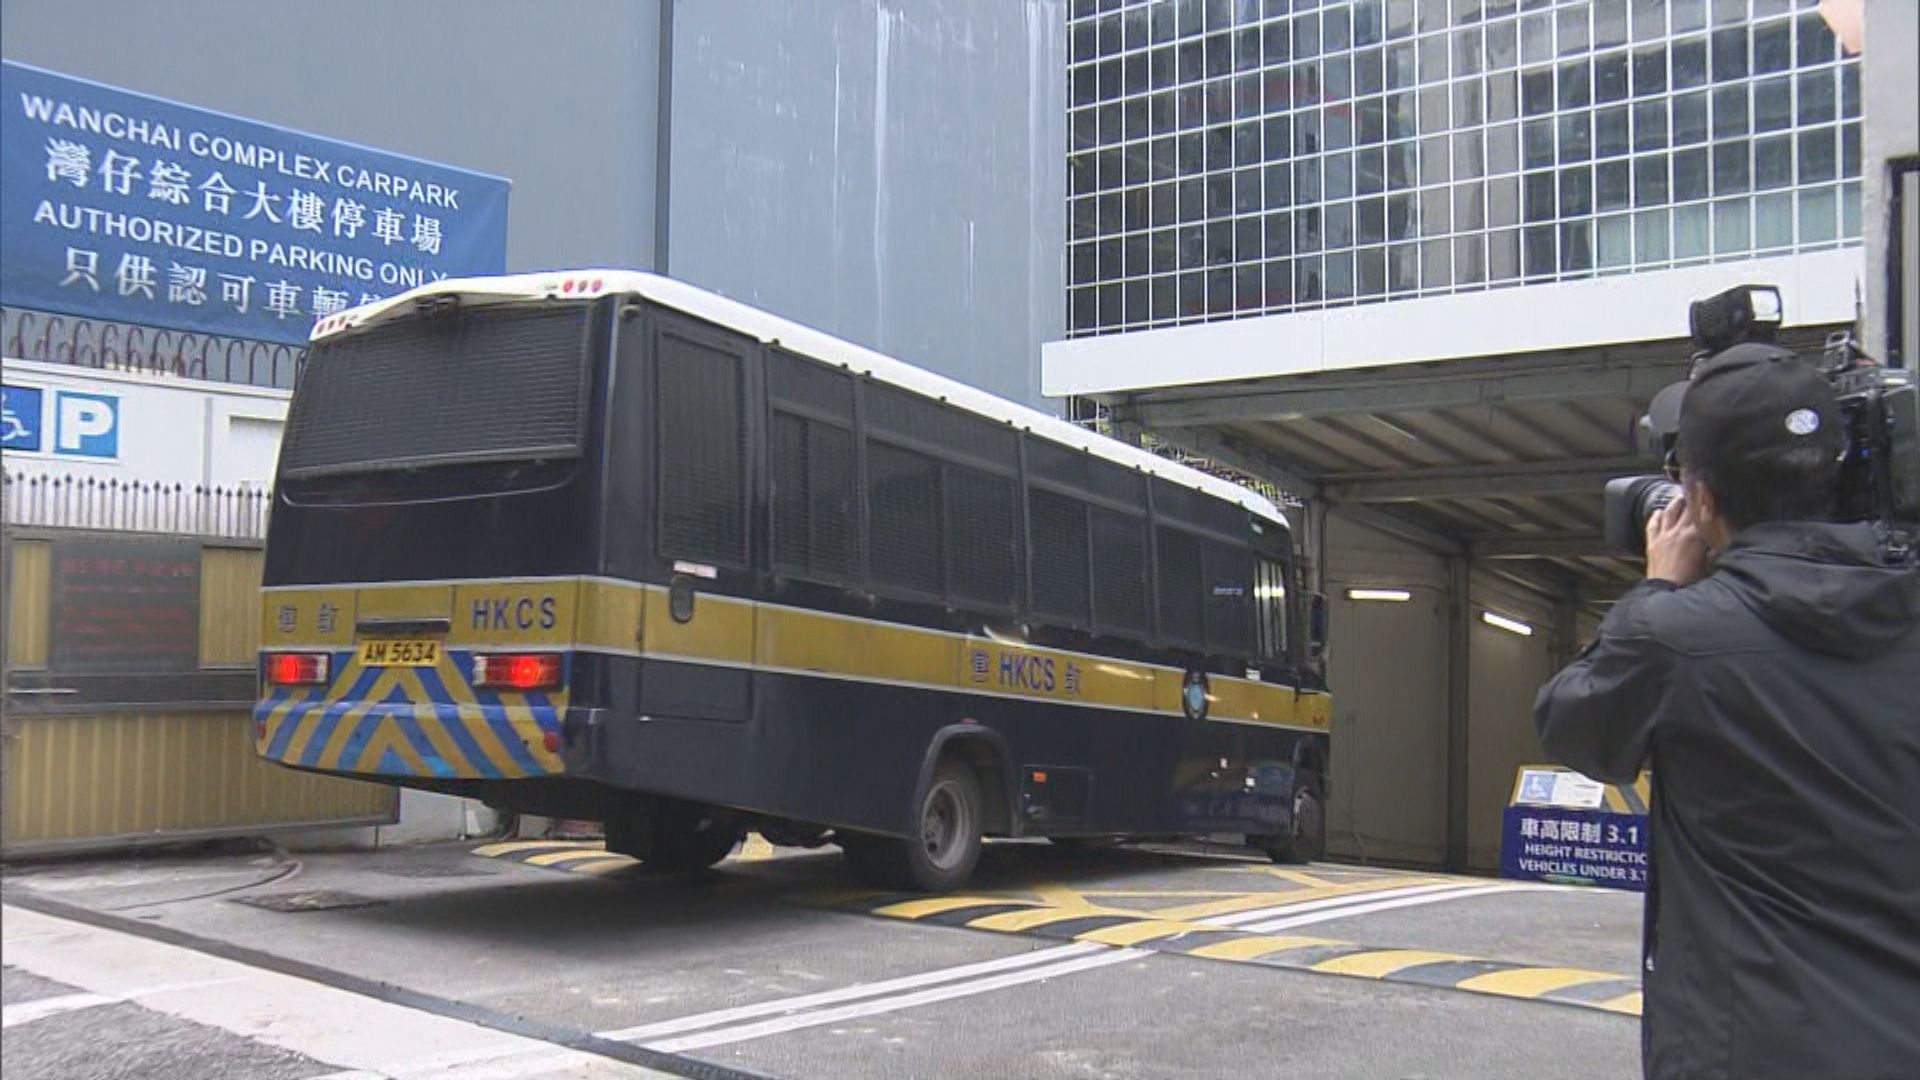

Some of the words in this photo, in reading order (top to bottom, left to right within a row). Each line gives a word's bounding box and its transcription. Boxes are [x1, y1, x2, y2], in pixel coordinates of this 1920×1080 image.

[20, 92, 181, 151] WANCHAI
[188, 131, 331, 183] COMPLEX
[336, 166, 460, 210] CARPARK
[45, 137, 443, 255] 灣仔綜合大樓停車場
[33, 200, 242, 257] AUTHORIZED
[250, 239, 374, 282] PARKING
[59, 396, 114, 449] P
[473, 598, 556, 630] HKCS
[364, 643, 387, 661] AM
[390, 643, 436, 662] 5634
[1000, 653, 1056, 691] HKCS
[1521, 818, 1600, 843] 車高限制
[1607, 824, 1639, 845] 3.1
[1524, 842, 1572, 859] HEIGHT
[1519, 858, 1578, 875] VEHICLES
[1579, 864, 1627, 880] UNDER
